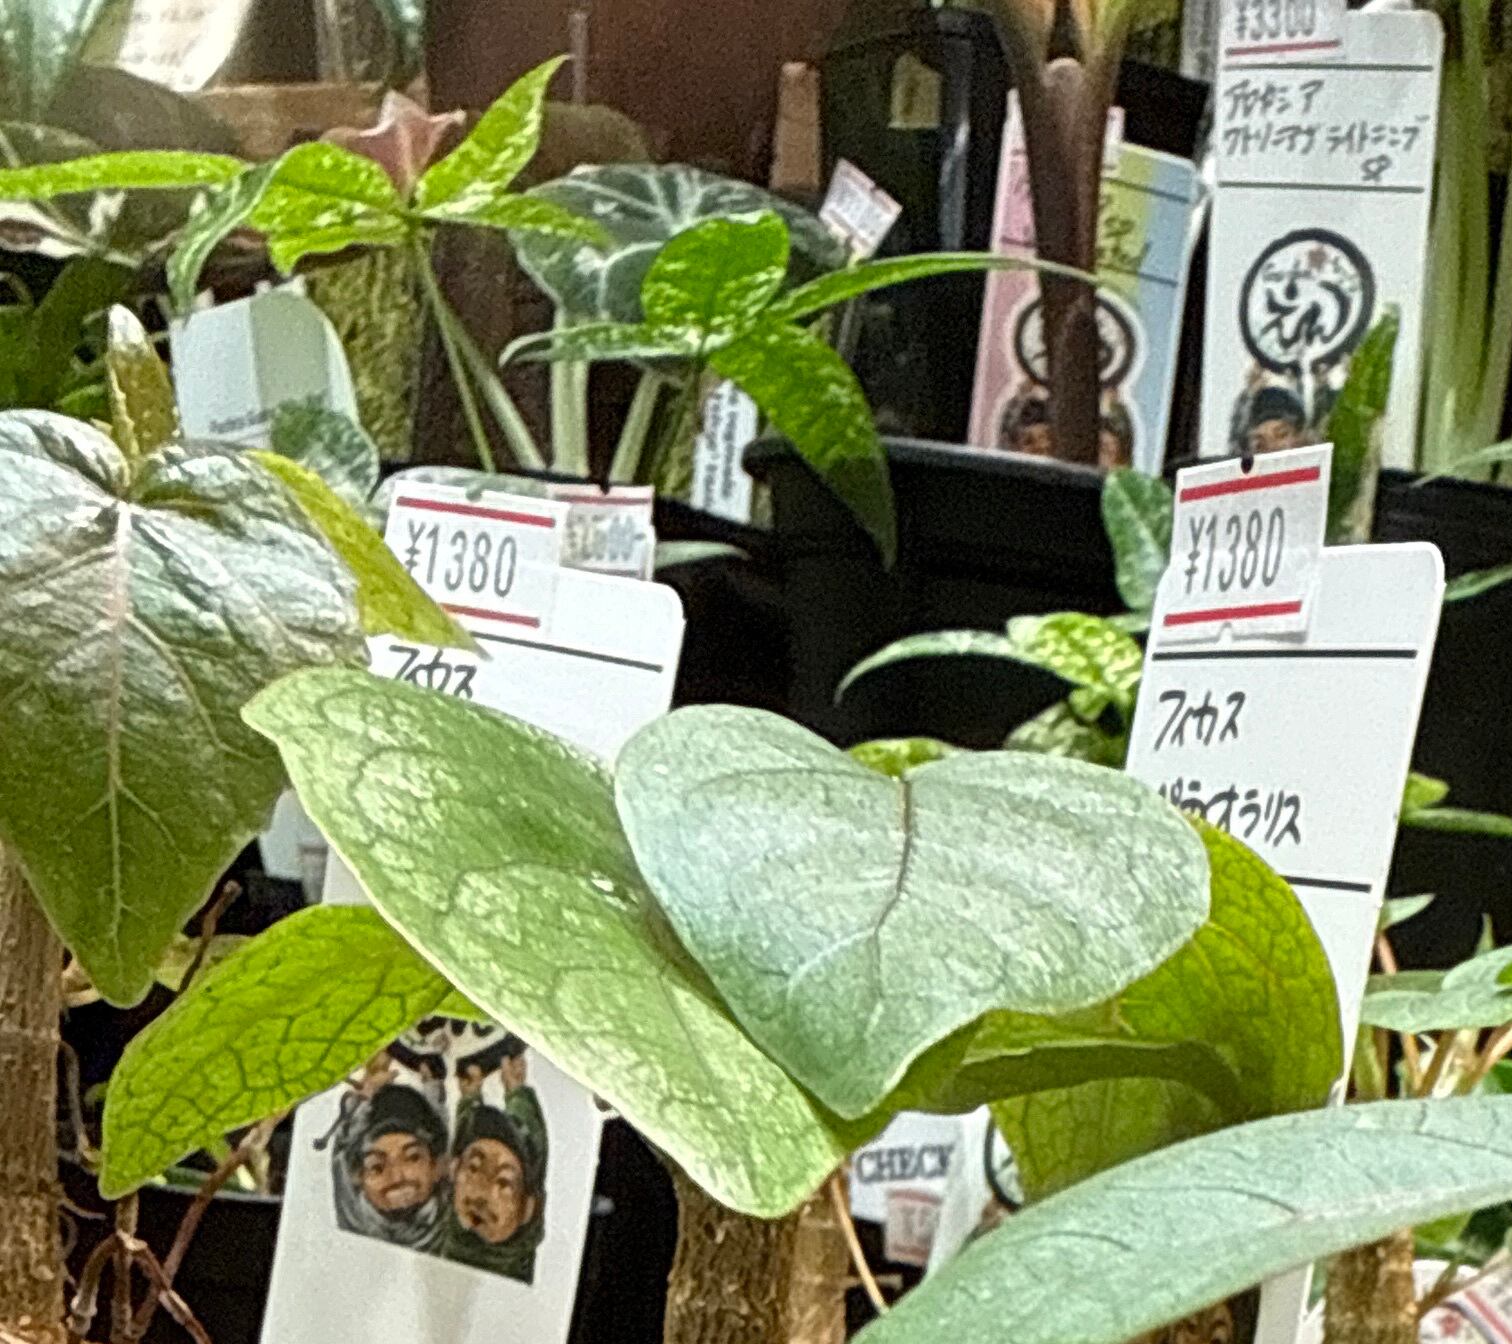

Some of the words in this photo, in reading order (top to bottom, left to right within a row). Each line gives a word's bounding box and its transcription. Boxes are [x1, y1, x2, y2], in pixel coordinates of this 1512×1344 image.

[404, 517, 518, 598] ¥1380
[1184, 505, 1286, 595] ¥1380
[1153, 688, 1248, 752] フィカス
